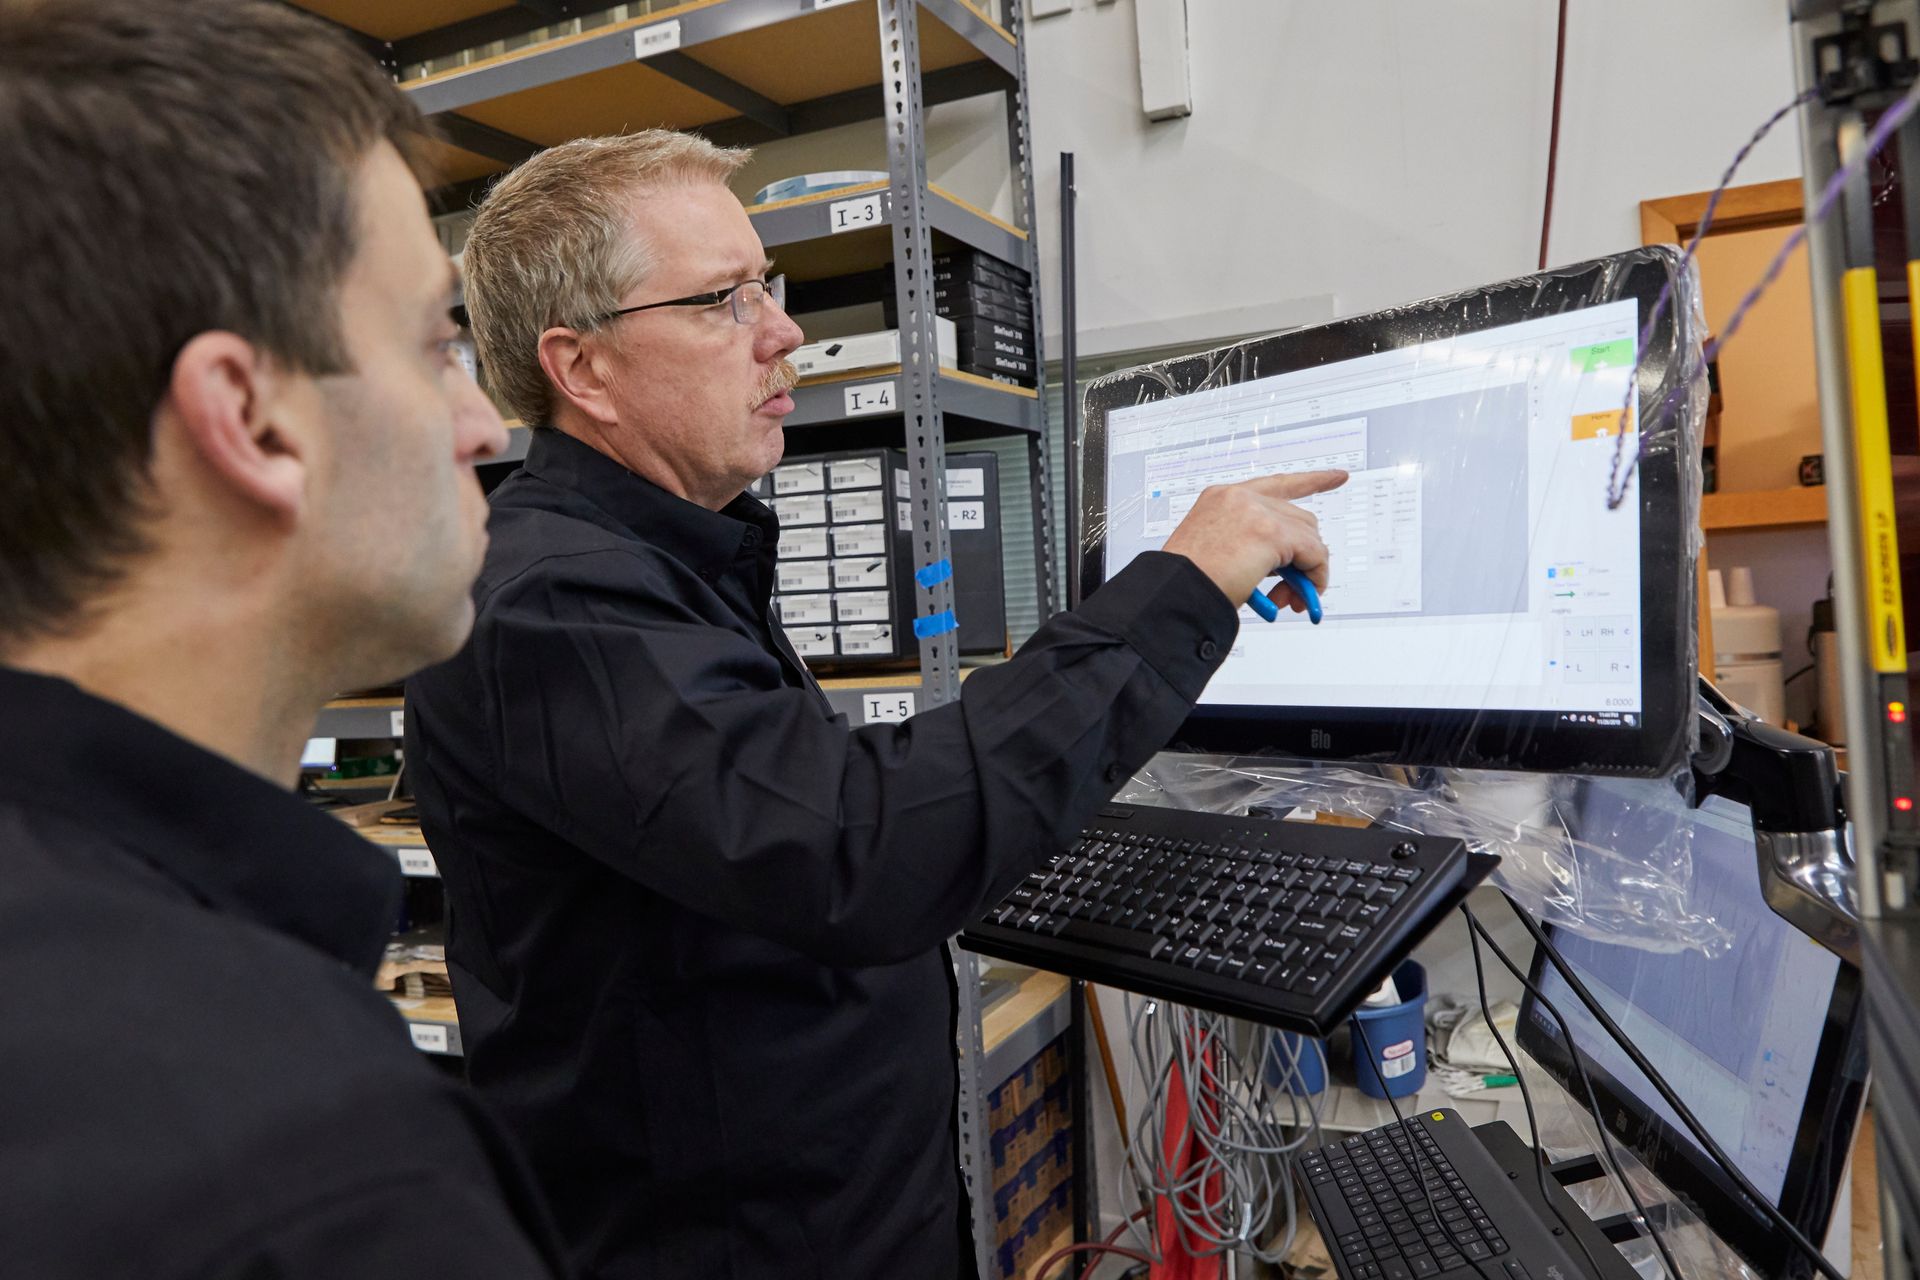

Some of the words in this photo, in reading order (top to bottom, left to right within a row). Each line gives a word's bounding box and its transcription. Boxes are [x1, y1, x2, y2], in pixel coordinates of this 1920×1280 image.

[962, 510, 977, 520] R2
[1581, 629, 1593, 637] LH
[1601, 628, 1614, 636] RH
[1611, 663, 1619, 672] R
